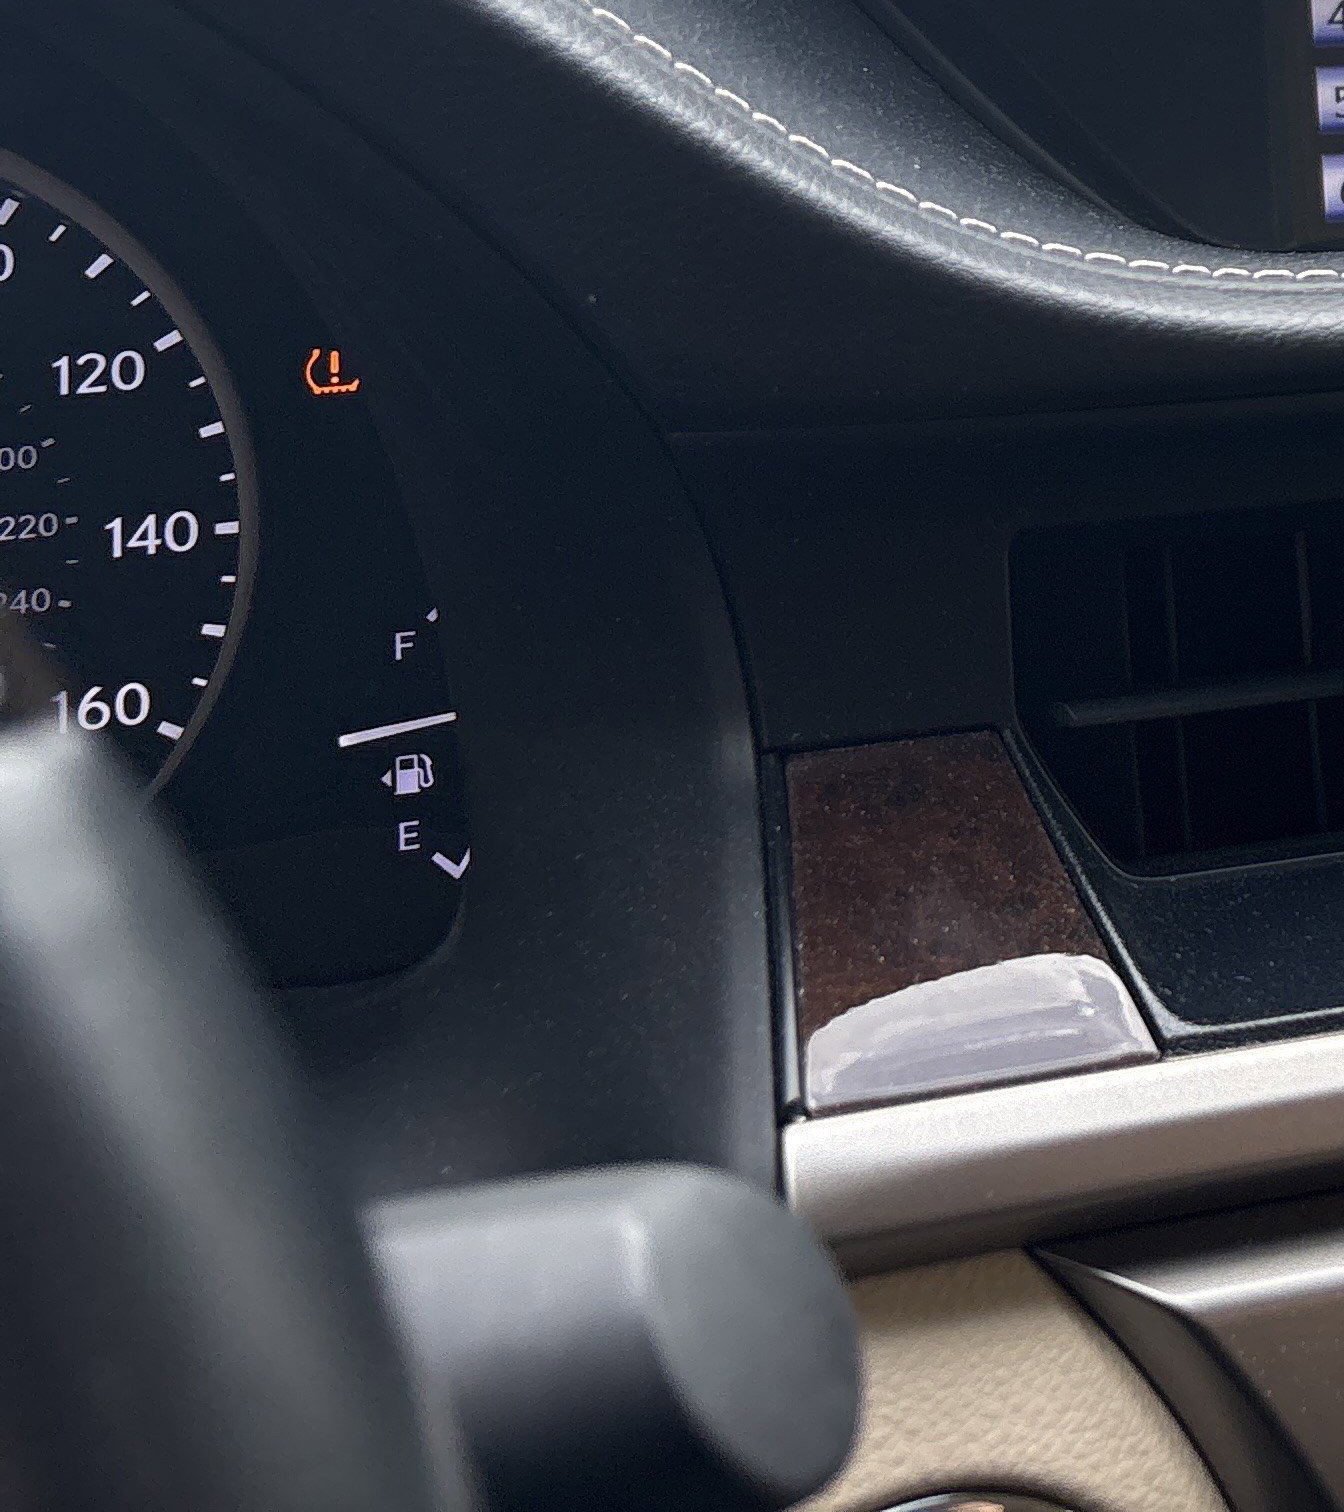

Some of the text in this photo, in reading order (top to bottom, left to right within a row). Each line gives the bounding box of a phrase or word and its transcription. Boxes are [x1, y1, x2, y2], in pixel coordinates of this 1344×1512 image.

[51, 350, 146, 396] 120
[0, 445, 39, 472] 00
[104, 510, 200, 558] 140
[395, 631, 416, 660] F
[52, 682, 151, 733] 160
[399, 820, 420, 850] E
